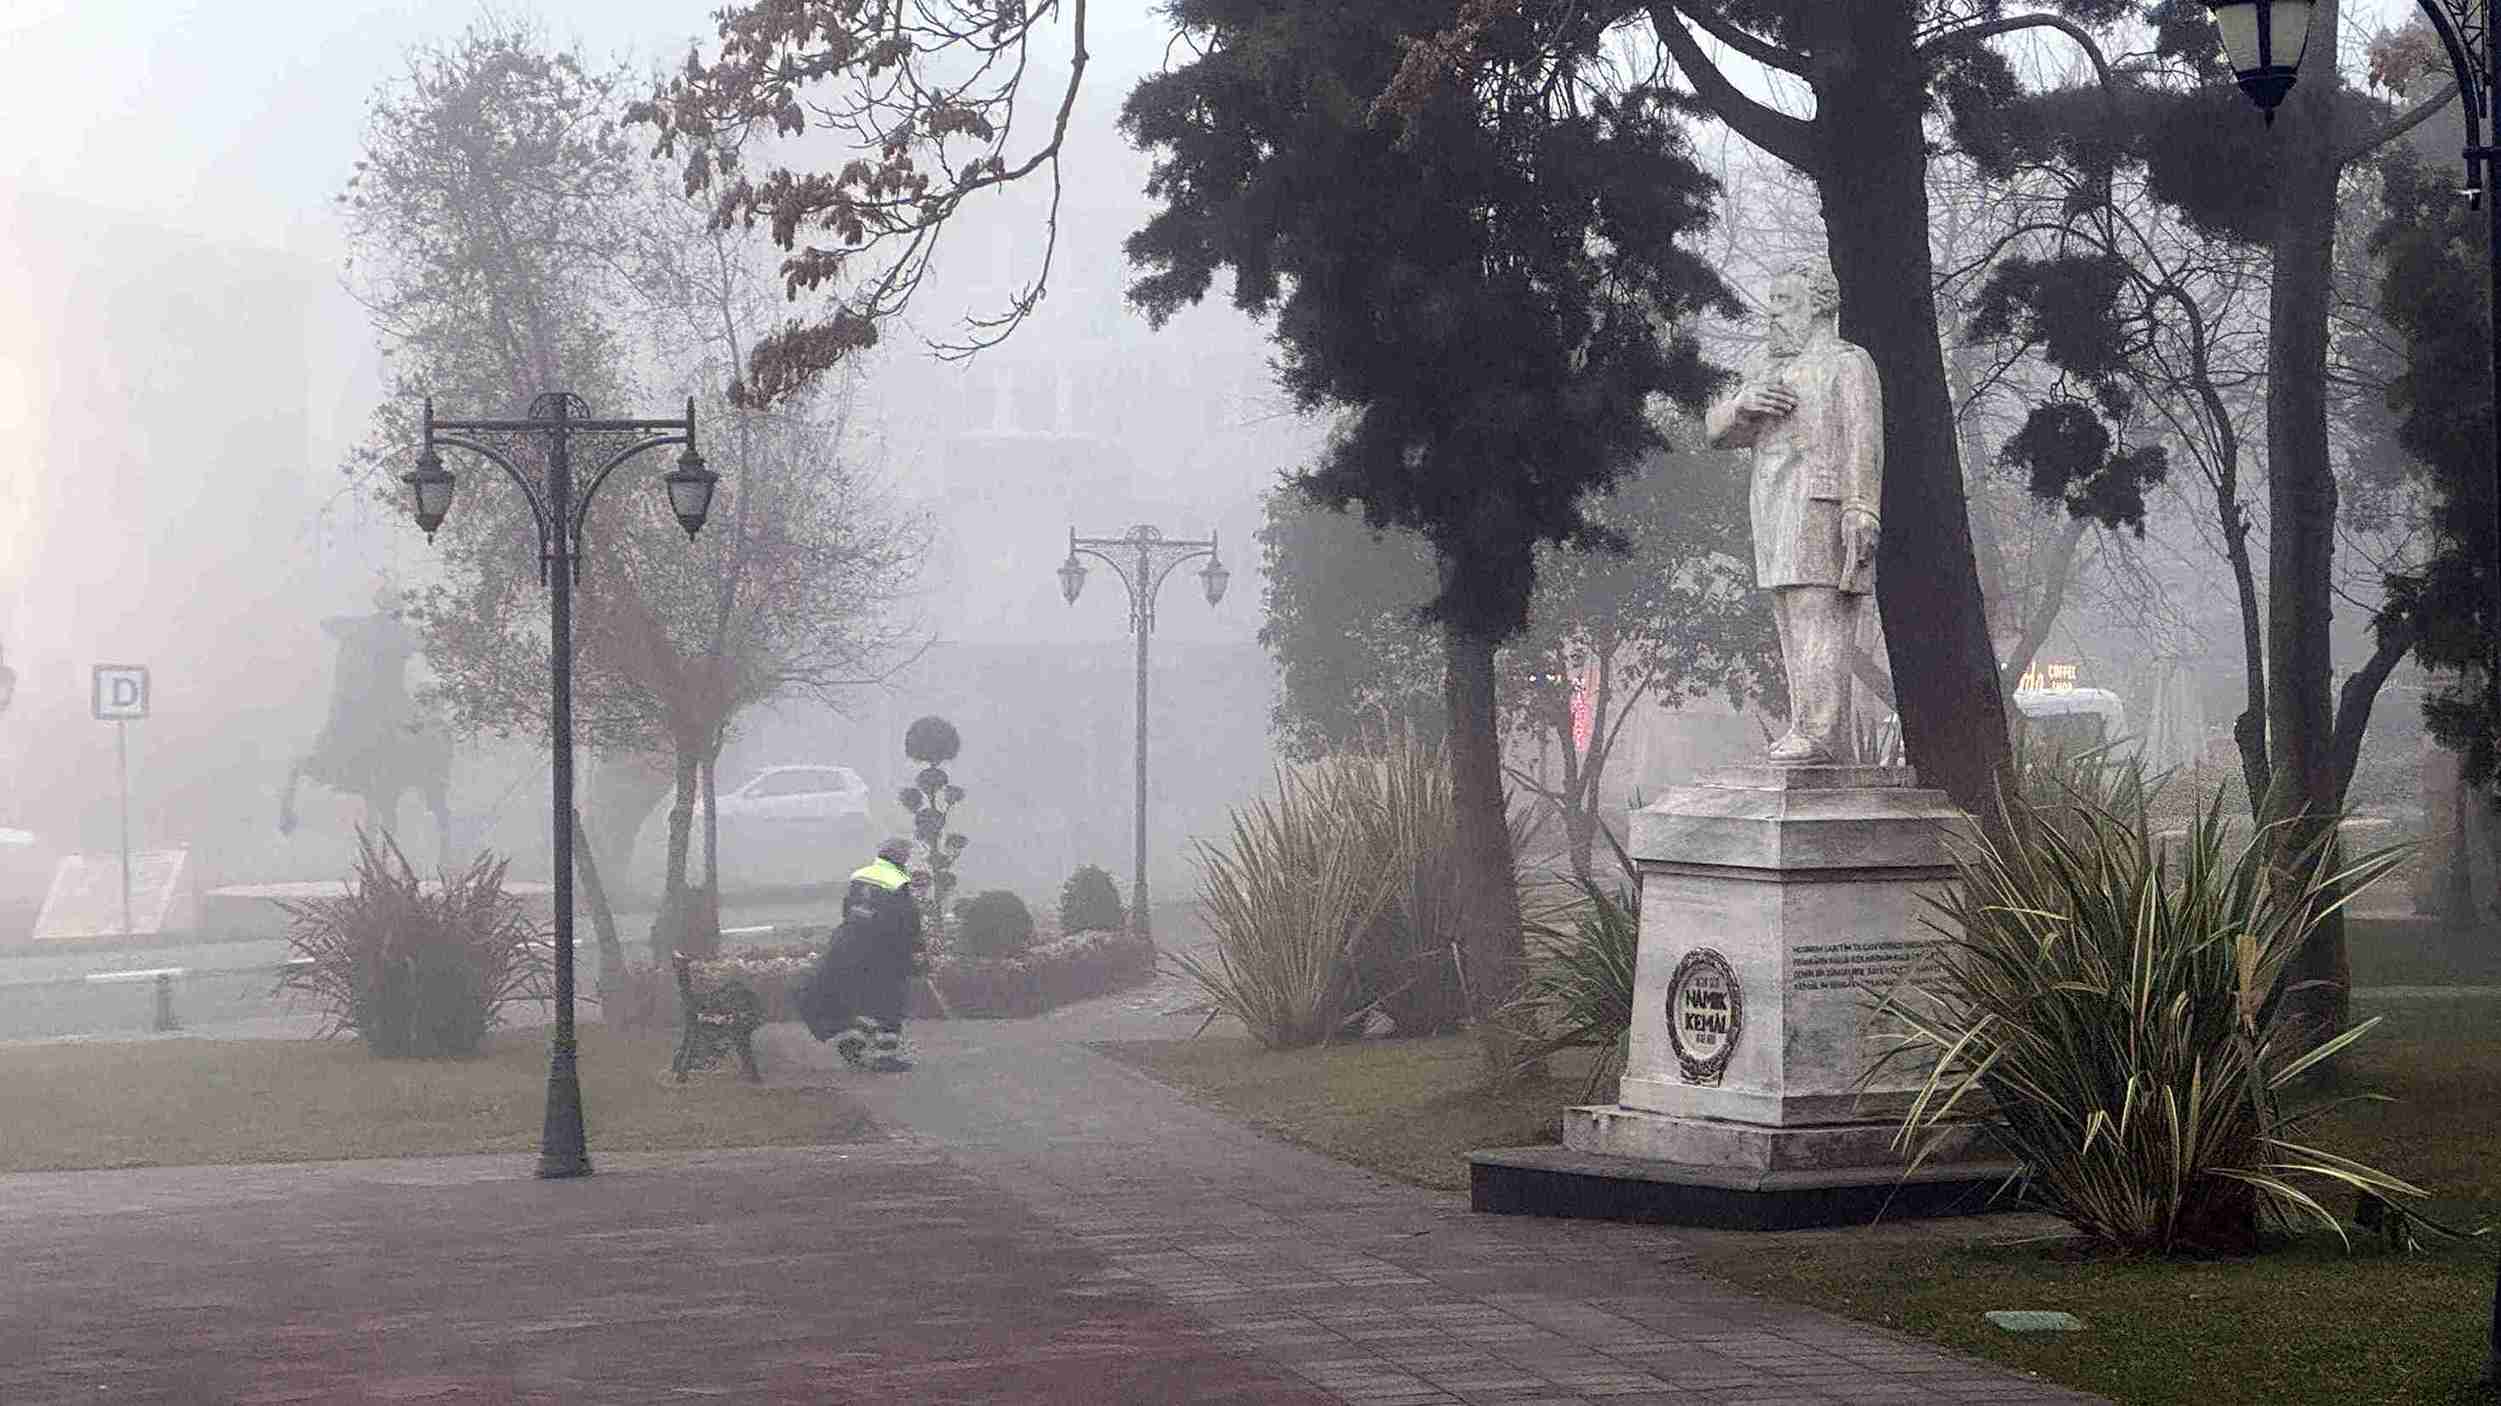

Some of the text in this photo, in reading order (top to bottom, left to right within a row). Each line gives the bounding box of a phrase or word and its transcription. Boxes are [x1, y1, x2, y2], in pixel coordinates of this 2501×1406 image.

[2047, 663, 2077, 681] COFFEE
[112, 677, 138, 706] D
[1685, 1012, 1728, 1034] KEMAL
